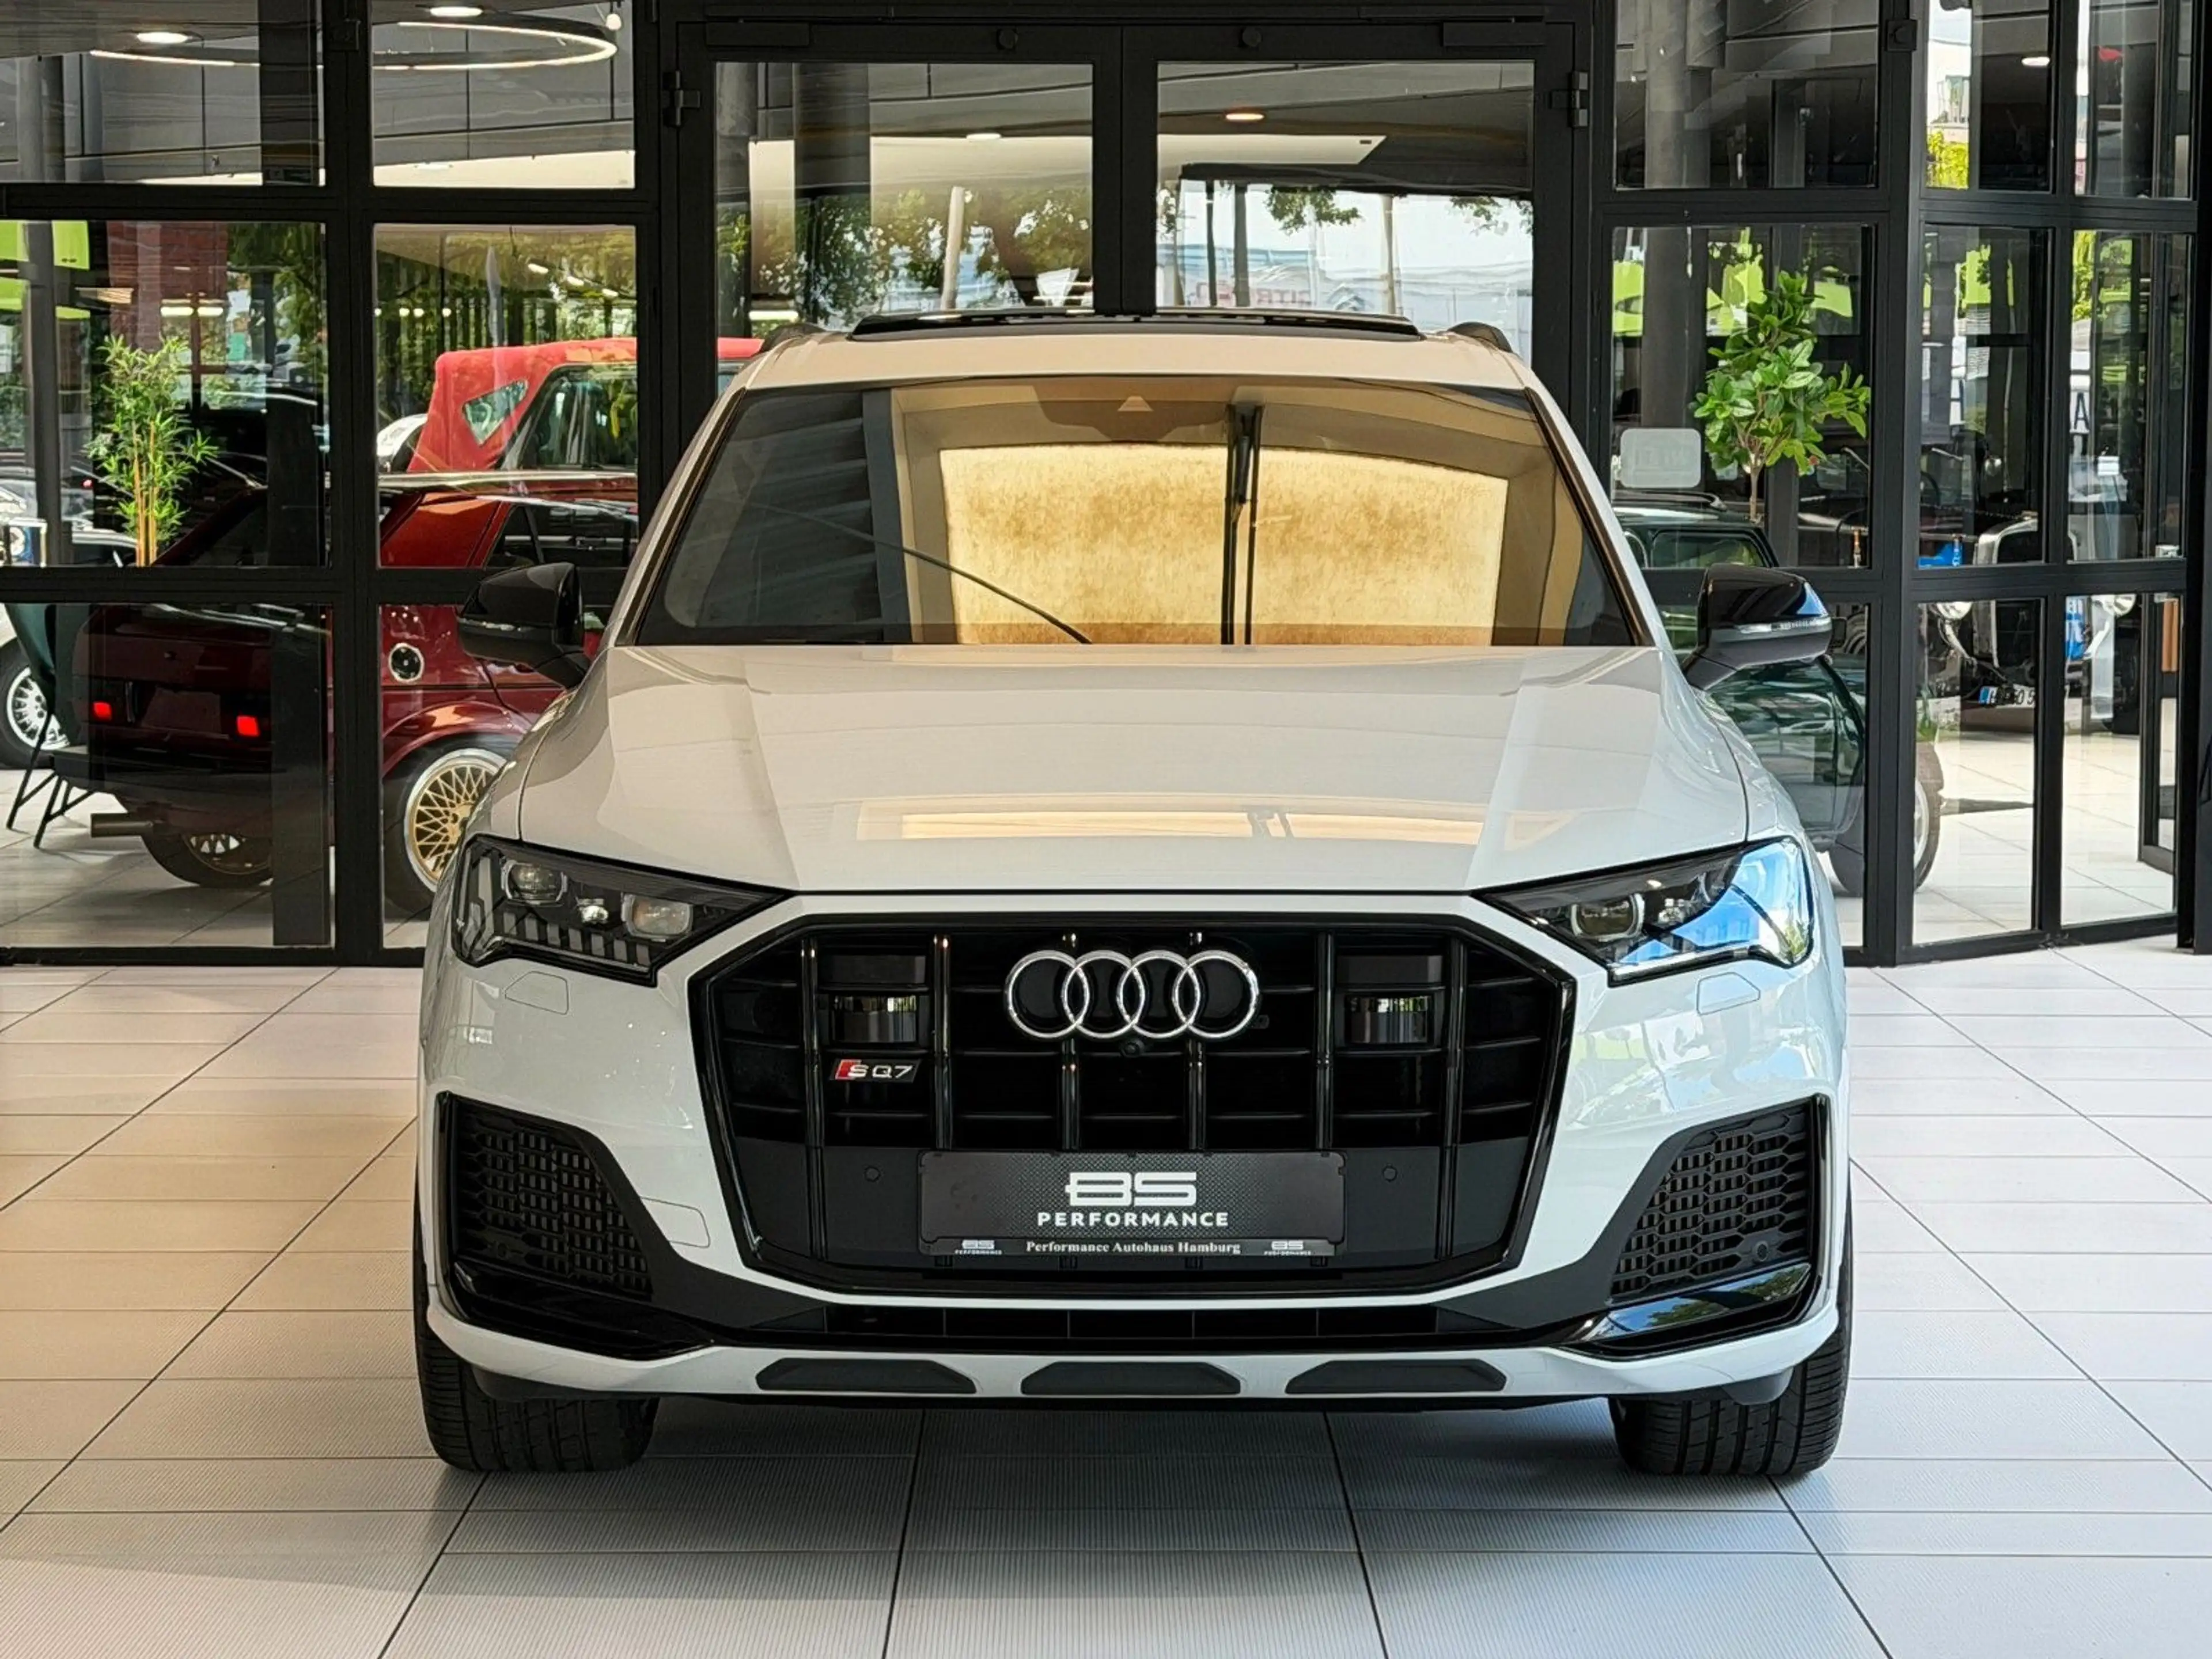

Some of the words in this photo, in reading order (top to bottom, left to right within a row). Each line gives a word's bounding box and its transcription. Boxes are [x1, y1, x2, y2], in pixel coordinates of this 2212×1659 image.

[847, 1065, 913, 1078] SQ7
[1037, 1212, 1228, 1227] PERFORMANCE
[1026, 1241, 1110, 1253] Performance
[1112, 1241, 1175, 1253] Autohaus
[1177, 1241, 1241, 1255] Hamburg
